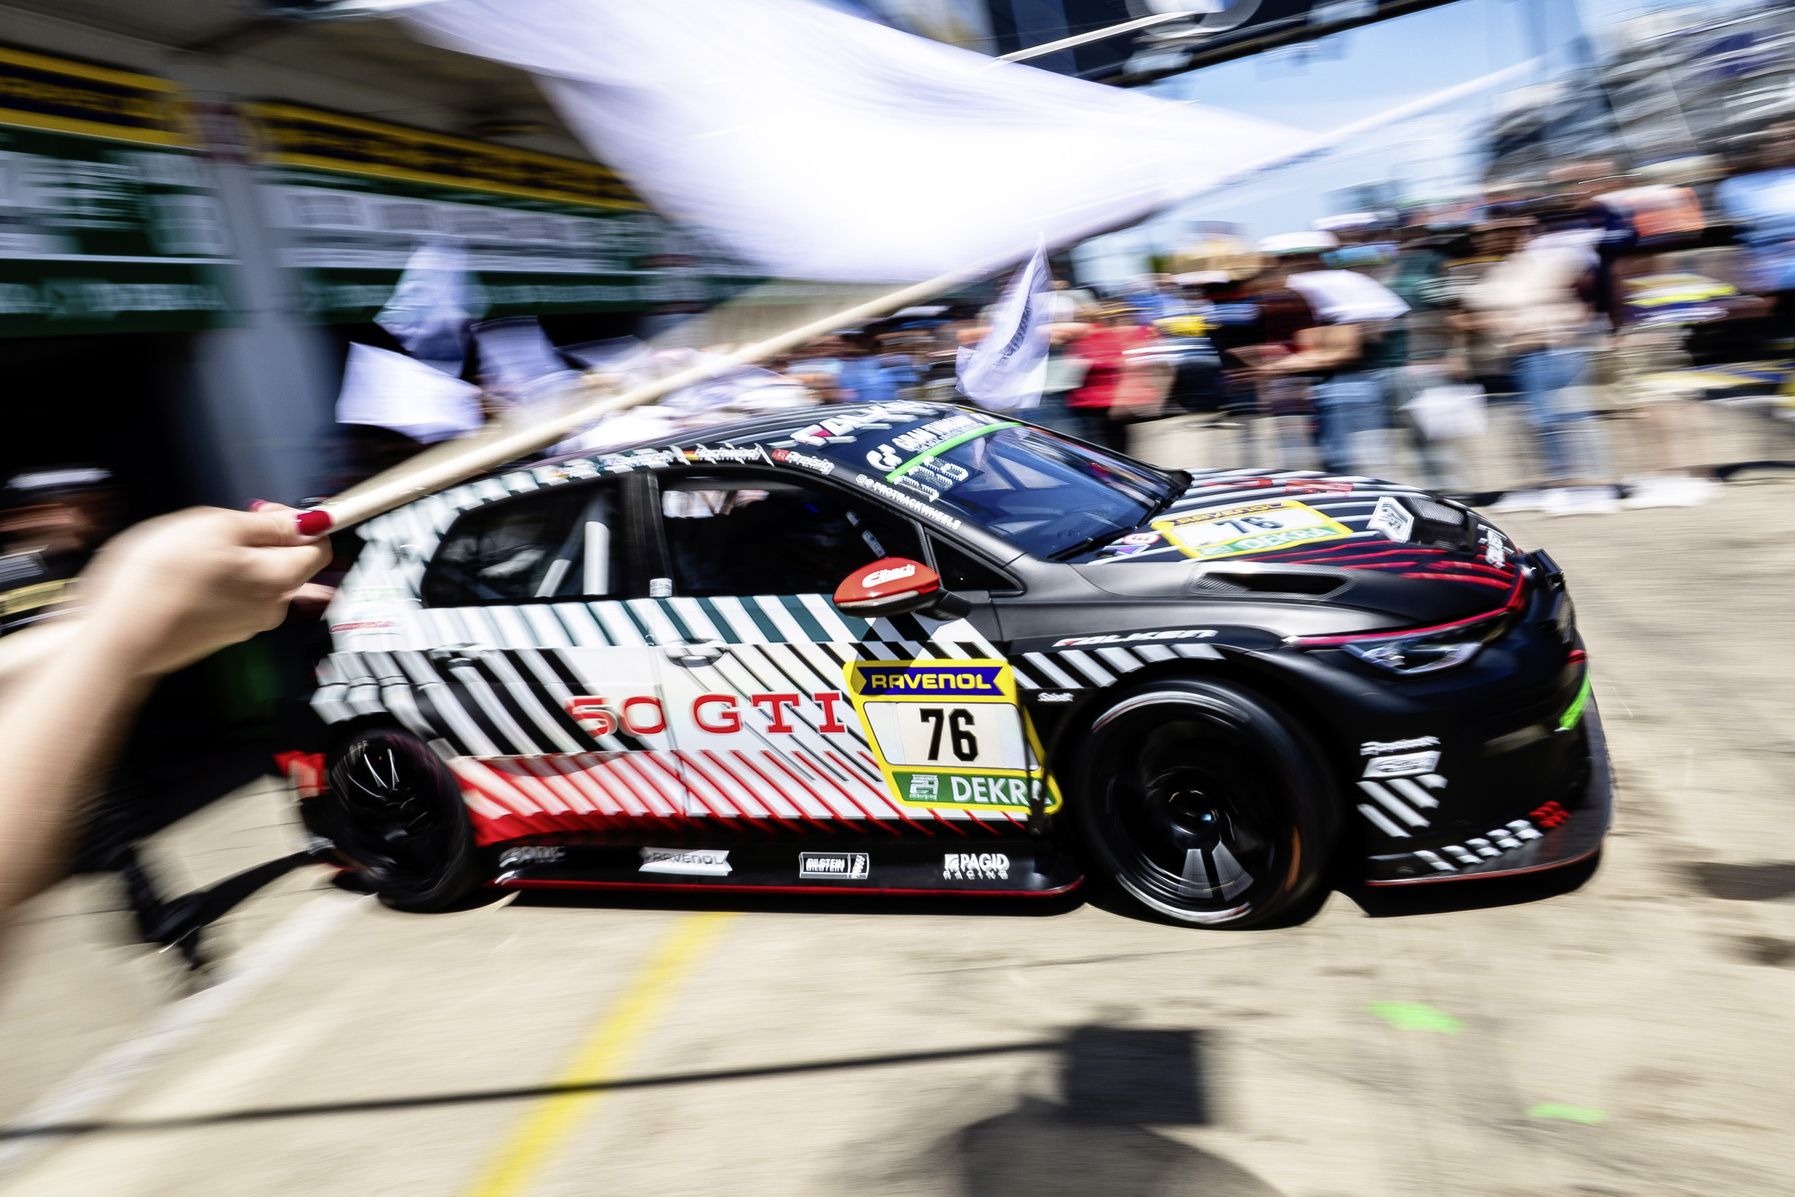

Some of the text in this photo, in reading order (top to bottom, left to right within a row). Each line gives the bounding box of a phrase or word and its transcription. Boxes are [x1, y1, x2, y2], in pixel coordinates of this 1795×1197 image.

[1213, 516, 1285, 534] 76
[1236, 528, 1339, 551] DEKRA
[1051, 629, 1219, 648] FALKEN
[871, 673, 992, 689] RAVENOL
[565, 691, 847, 739] 50 GTI
[919, 707, 979, 762] 76
[651, 851, 726, 866] RAVENOL
[806, 858, 845, 872] BILSTEIN
[960, 853, 1010, 872] PAGID
[943, 870, 1010, 880] RACING
